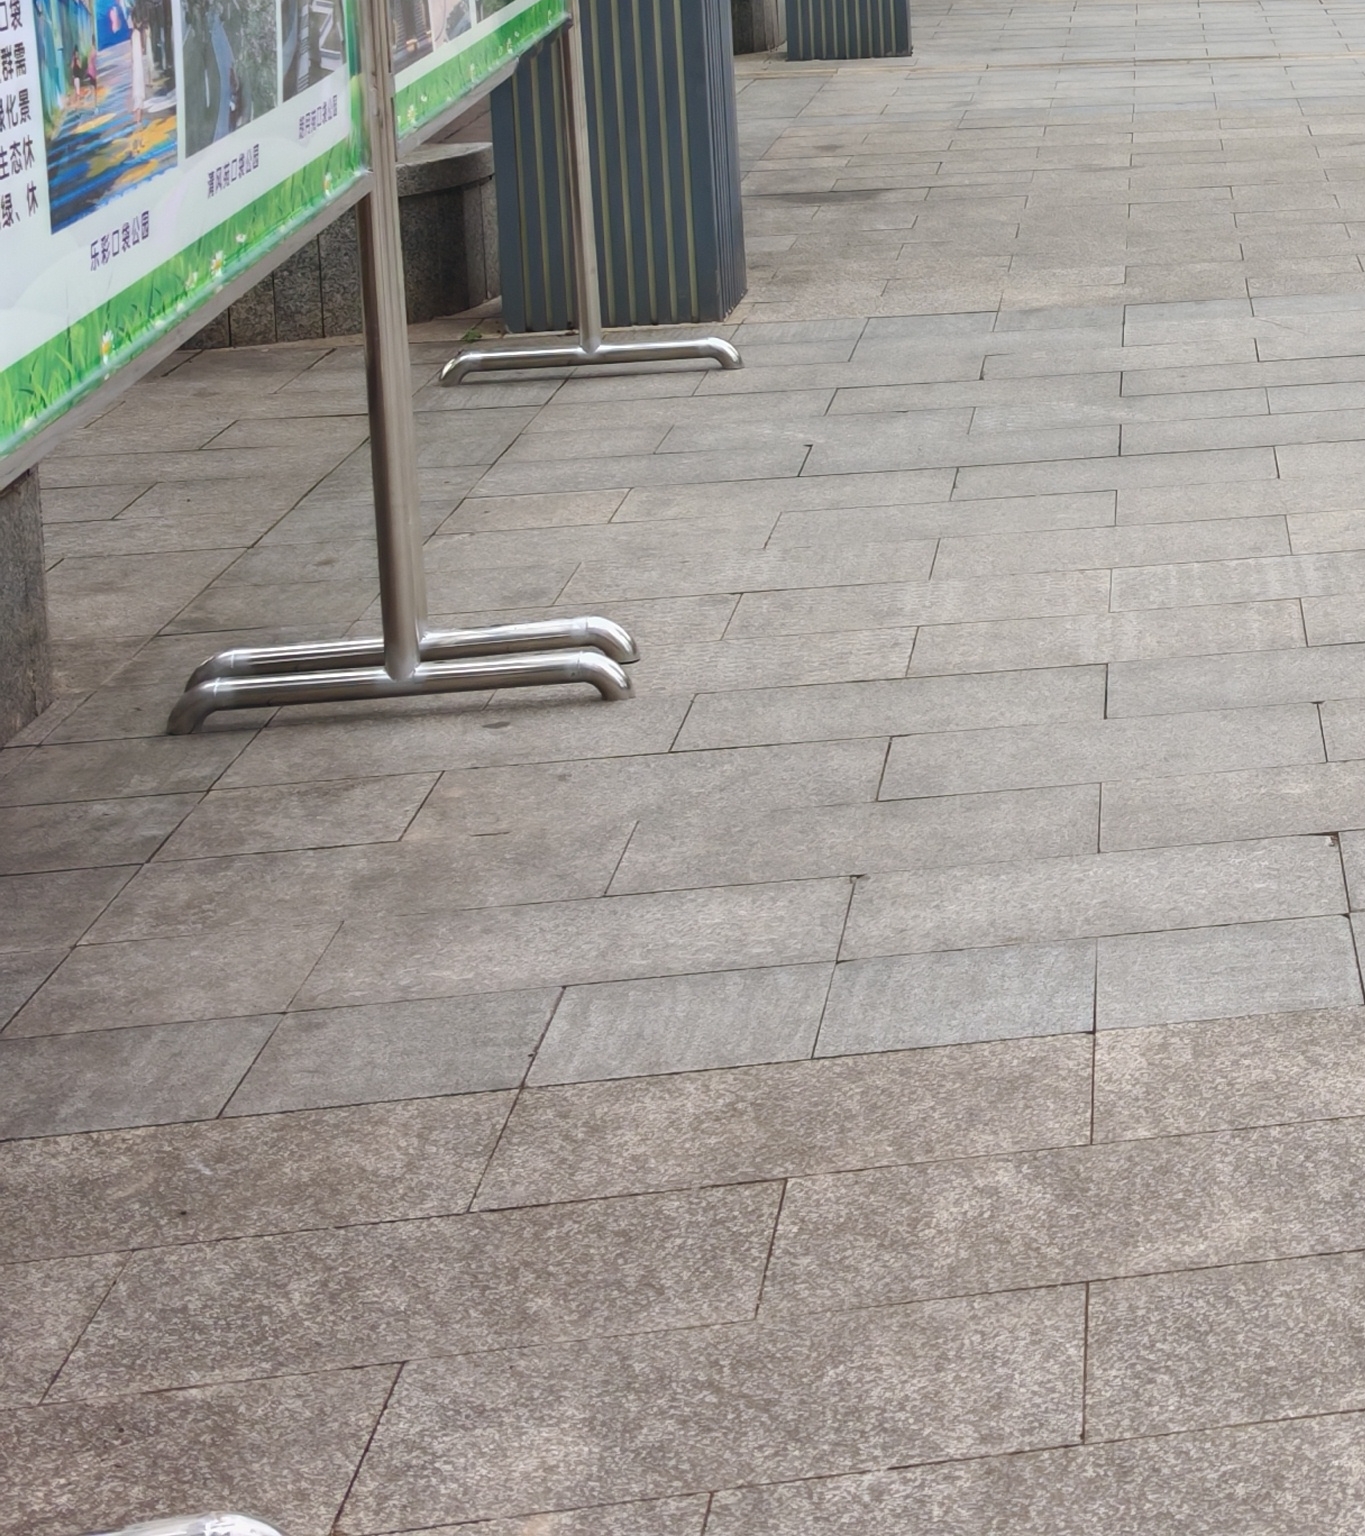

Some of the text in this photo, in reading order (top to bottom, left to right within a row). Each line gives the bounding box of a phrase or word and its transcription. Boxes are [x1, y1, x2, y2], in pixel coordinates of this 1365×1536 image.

[90, 210, 150, 272] 乐彩口袋公园
